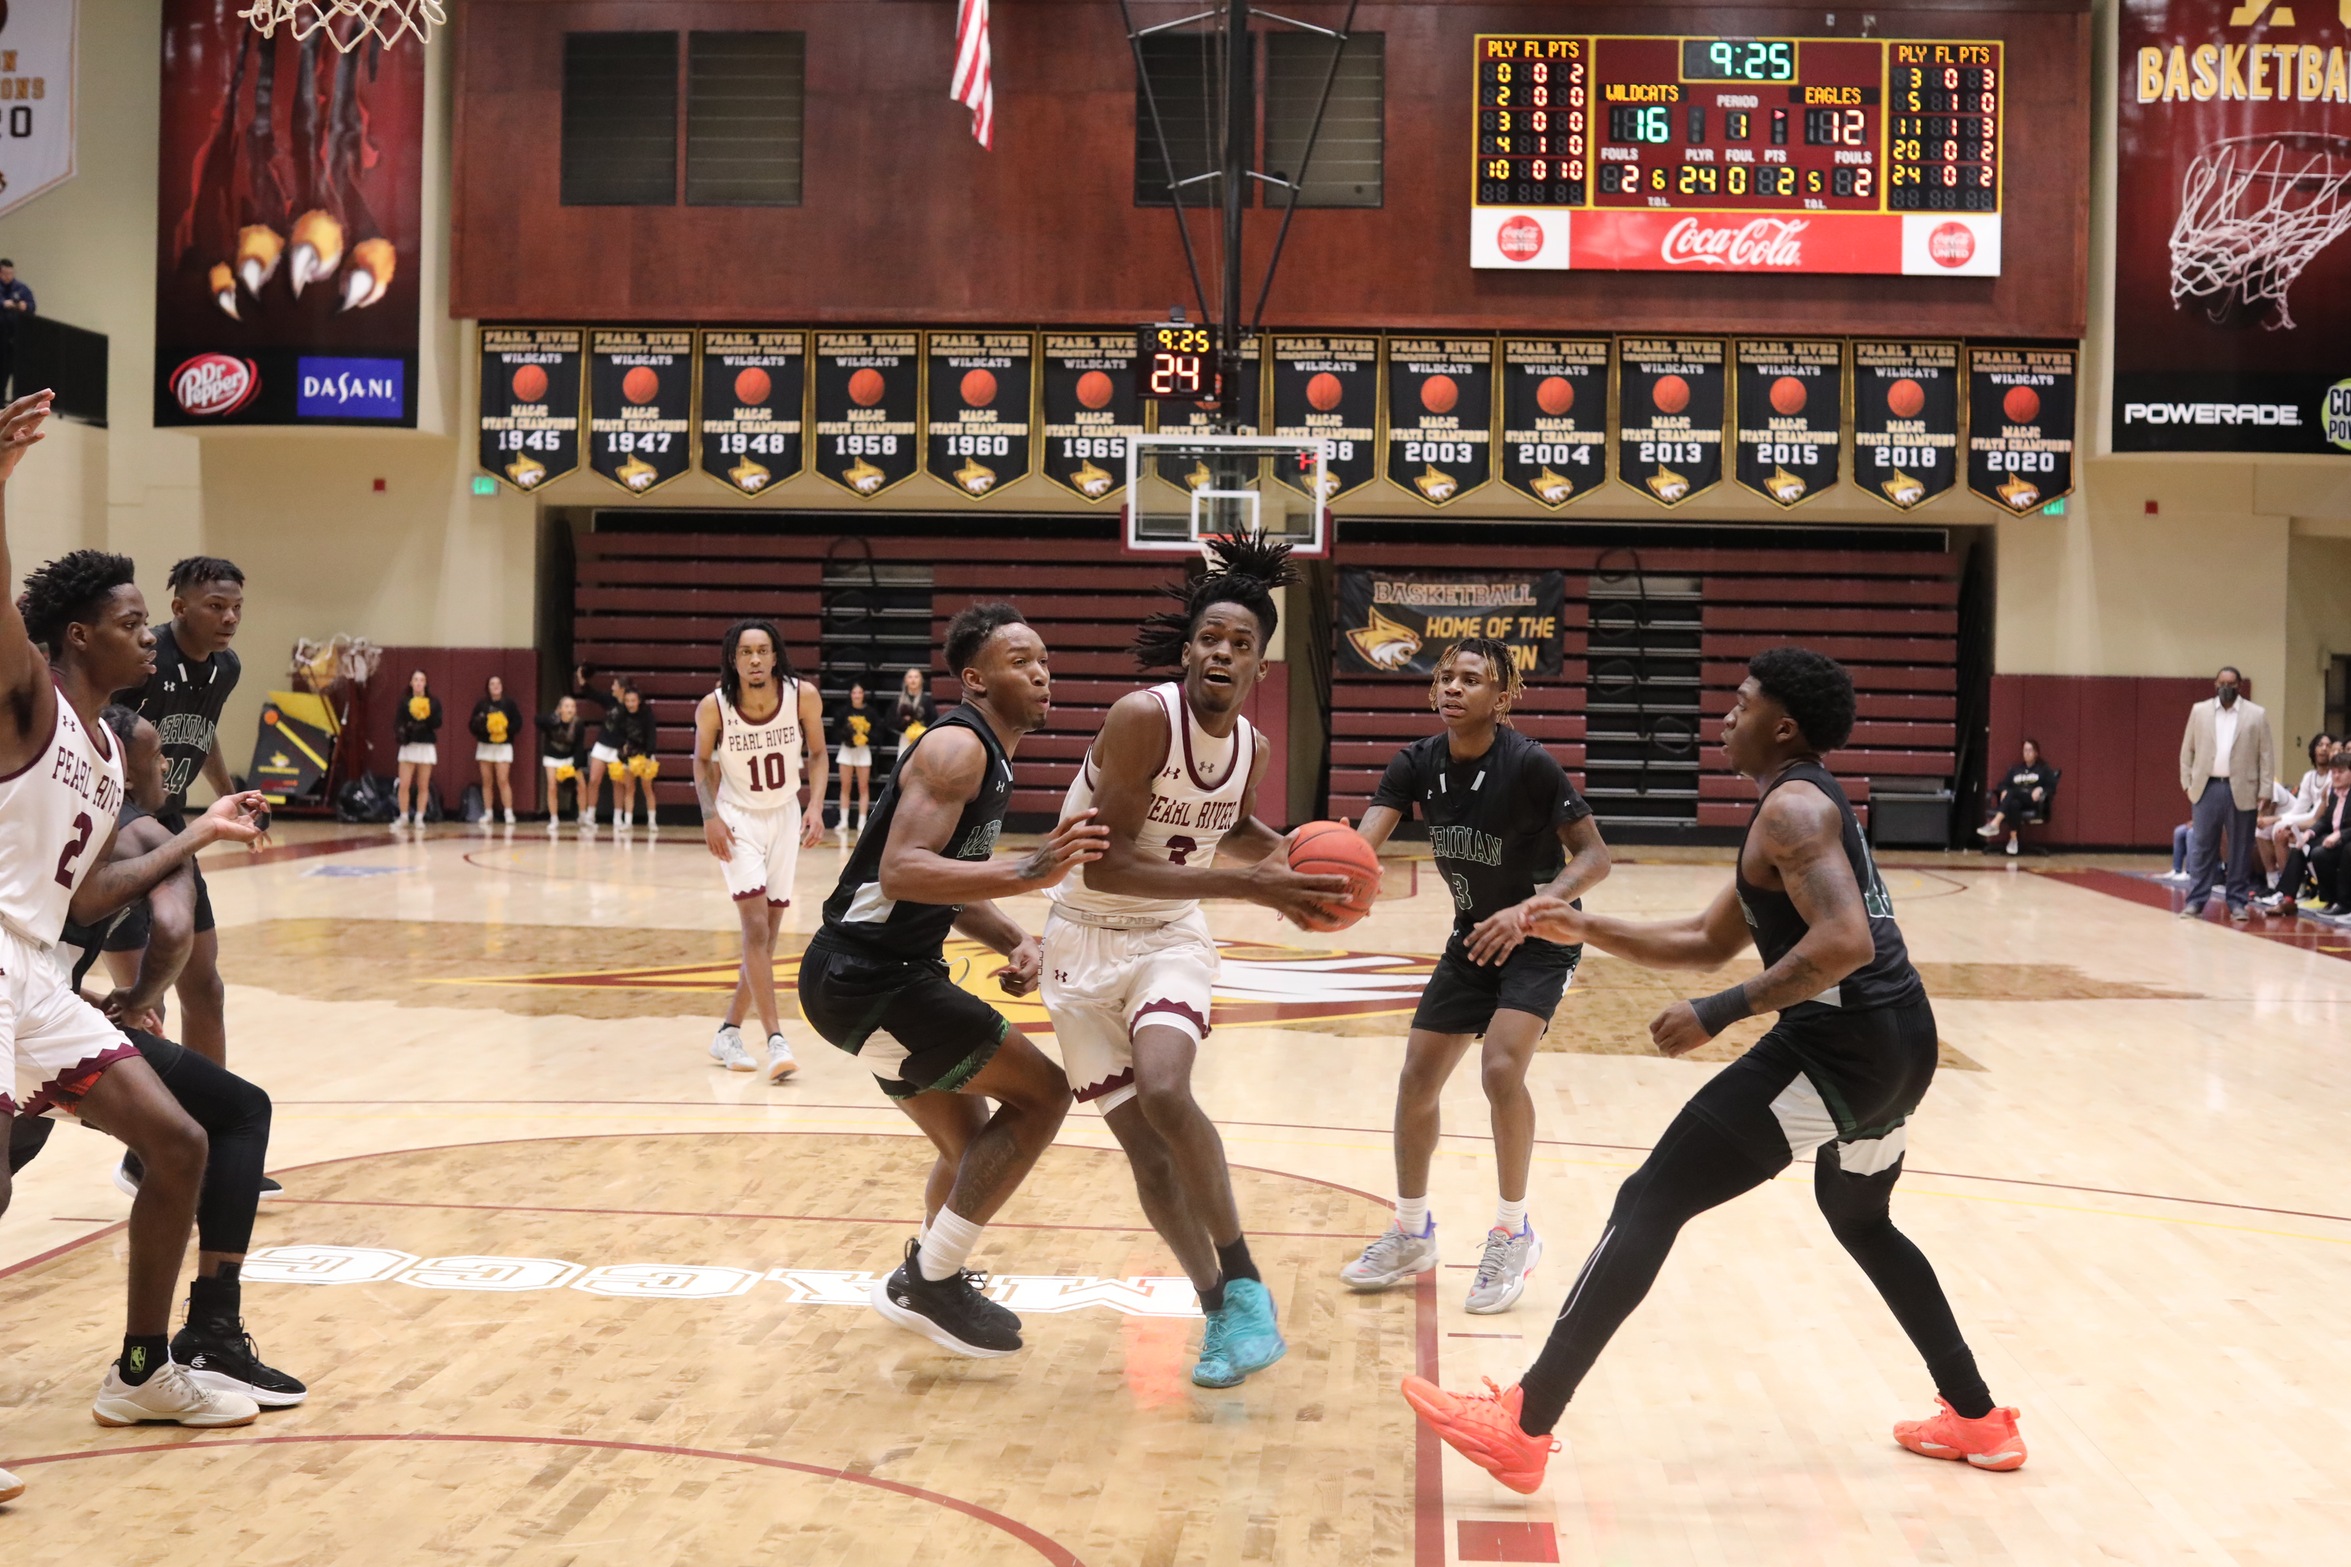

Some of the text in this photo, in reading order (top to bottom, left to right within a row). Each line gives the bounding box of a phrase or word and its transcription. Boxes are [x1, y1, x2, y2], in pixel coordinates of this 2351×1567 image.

[1488, 41, 1579, 58] PLY FL PTS
[1899, 46, 1989, 64] PLY FL PTS
[1710, 42, 1790, 79] 9:25
[1497, 63, 1584, 84] 0 0 2
[1910, 68, 1994, 90] 3 0 3
[2137, 43, 2351, 104] BASKETBA
[1497, 86, 1584, 107] 2 0 0
[1606, 84, 1679, 102] WILDCATS
[1717, 95, 1759, 108] PERIOD
[1805, 87, 1861, 104] EAGLES
[1952, 94, 1958, 110] 1
[1981, 92, 1994, 113] 0
[1499, 111, 1583, 132] 3 0 0
[1637, 107, 1668, 143] 16
[1740, 115, 1746, 137] 1
[1833, 110, 1864, 145] 12
[1952, 119, 1957, 135] 1
[1982, 117, 1994, 138] 3
[1497, 135, 1583, 155] 4 1 0
[1601, 148, 1638, 160] FOULS
[1685, 149, 1714, 161] PLYR
[1893, 140, 1994, 161] 20 0 2
[1725, 149, 1755, 162] FOUL
[1764, 150, 1786, 162] PTS
[1835, 151, 1872, 163] FOULS
[1489, 159, 1583, 180] 10 0 10
[1622, 165, 1639, 193] 2
[1652, 169, 1665, 189] 6
[1892, 165, 1993, 187] 24 0 2
[1679, 166, 1716, 194] 24
[1728, 166, 1746, 194] 0
[1777, 168, 1794, 195] 2
[1854, 168, 1872, 196] 2
[1661, 217, 1811, 266] Coca-Cola
[485, 331, 532, 343] PEARL
[594, 332, 642, 345] PEARL
[706, 334, 754, 346] PEARL
[818, 334, 867, 346] PEARL
[931, 335, 980, 347] PEARL
[1046, 337, 1096, 348] PEARL
[1158, 329, 1209, 352] 9:25
[1276, 339, 1325, 351] PEARL
[1390, 341, 1440, 353] PEARL
[1622, 340, 1673, 353] PEARL
[1506, 342, 1556, 354] PEARL
[1739, 342, 1788, 355] PEARL
[1857, 344, 1906, 357] PEARL
[1973, 351, 2022, 364] PEARL
[501, 353, 562, 364] WILDCATS
[611, 355, 673, 365] WILDCATS
[723, 356, 785, 366] WILDCATS
[835, 357, 899, 367] WILDCATS
[948, 357, 1011, 368] WILDCATS
[1063, 359, 1127, 369] WILDCATS
[1293, 361, 1357, 372] WILDCATS
[1408, 363, 1473, 374] WILDCATS
[200, 362, 226, 386] Dr
[1151, 353, 1199, 393] 24
[1524, 364, 1589, 376] WILDCATS
[1640, 363, 1704, 375] WILDCATS
[1757, 364, 1821, 376] WILDCATS
[1874, 367, 1938, 379] WILDCATS
[184, 367, 242, 408] Pepper
[303, 372, 392, 404] DASANI
[1990, 373, 2054, 386] WILDCATS
[2124, 403, 2299, 425] POWERADE
[498, 430, 560, 450] 1945
[607, 432, 672, 453] 1947
[720, 434, 785, 454] 1948
[835, 435, 897, 455] 1958
[947, 435, 1009, 456] 1960
[1063, 438, 1125, 458] 1965
[1404, 442, 1473, 463] 2003
[1519, 444, 1590, 465] 2004
[1639, 442, 1702, 463] 2013
[1757, 443, 1818, 465] 2015
[1874, 446, 1937, 468] 2018
[1987, 451, 2055, 472] 2020
[1373, 582, 1537, 606] BASKETBALL
[1425, 616, 1556, 638] HOME OF THE
[729, 726, 796, 752] PEARL RIVER
[51, 746, 93, 800] PEARL
[747, 752, 786, 792] 10
[1195, 800, 1237, 830] RIVER
[54, 811, 93, 890] 2
[1452, 872, 1473, 910] 3
